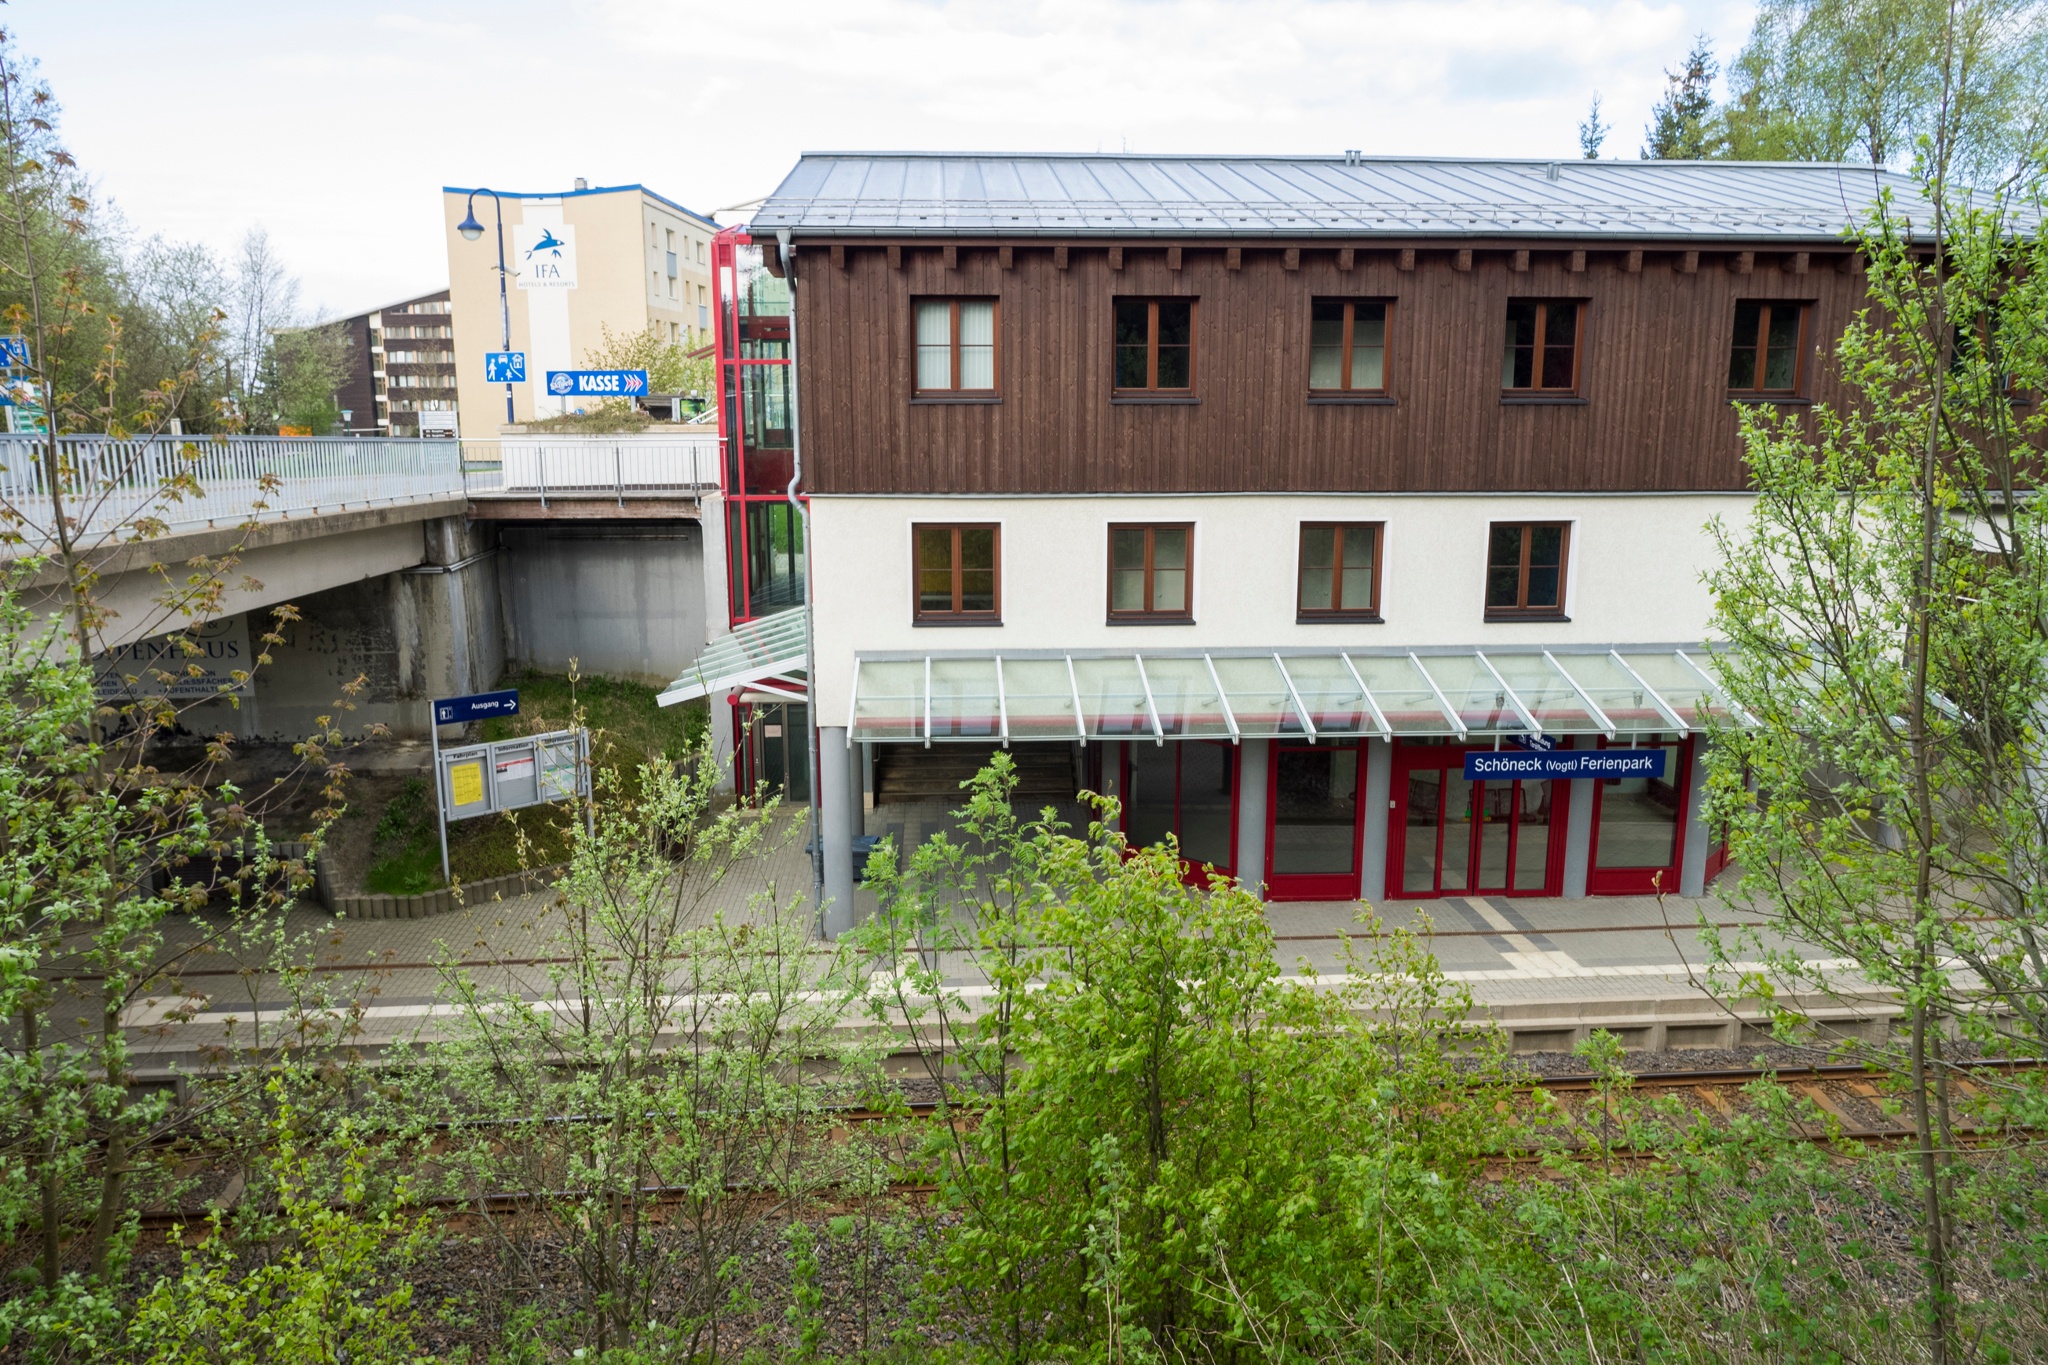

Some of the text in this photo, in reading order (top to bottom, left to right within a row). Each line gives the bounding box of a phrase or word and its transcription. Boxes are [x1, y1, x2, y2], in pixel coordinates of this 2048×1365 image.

[535, 264, 560, 278] IFA
[578, 375, 619, 391] KASSE
[471, 700, 499, 710] Ausgang
[1475, 756, 1653, 773] Schöneck (Vogtl) Ferienpark
